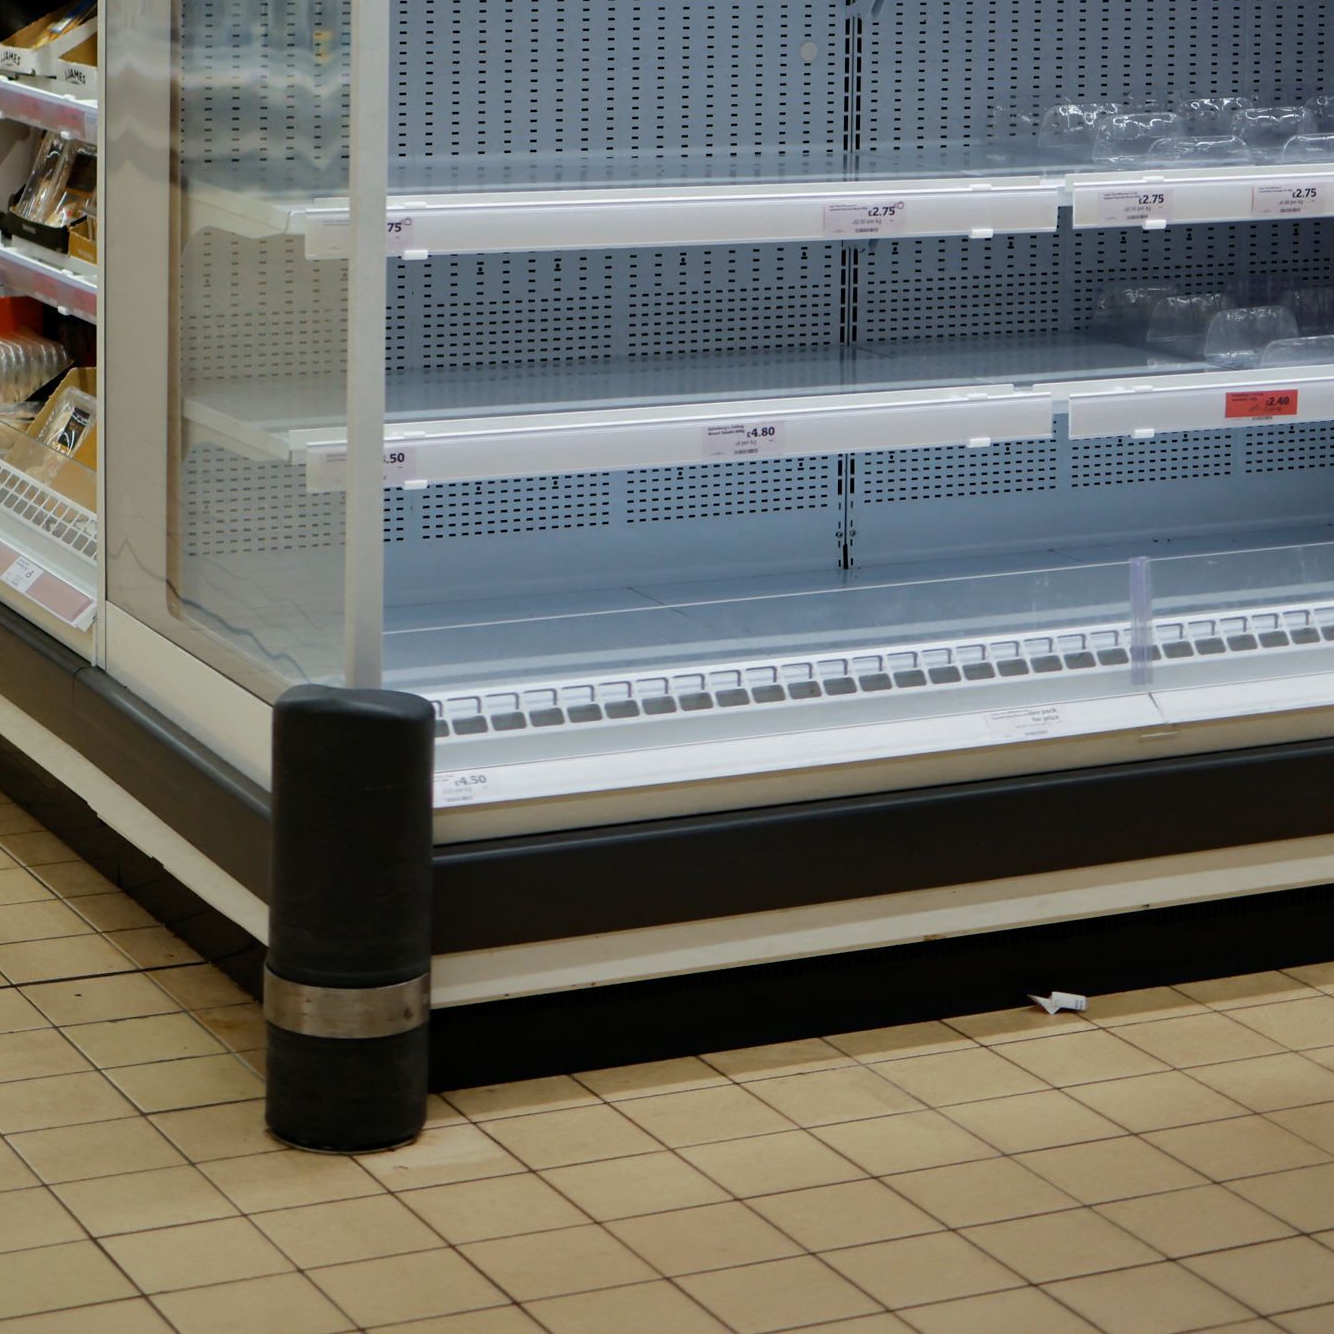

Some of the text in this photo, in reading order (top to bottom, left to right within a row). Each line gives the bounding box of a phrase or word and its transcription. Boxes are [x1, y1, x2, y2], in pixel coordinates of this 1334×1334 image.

[1292, 187, 1317, 198] £2.75
[1138, 194, 1164, 205] £2.75
[868, 206, 896, 217] £2.75
[747, 426, 775, 438] £4.80
[454, 775, 487, 787] £4.50
